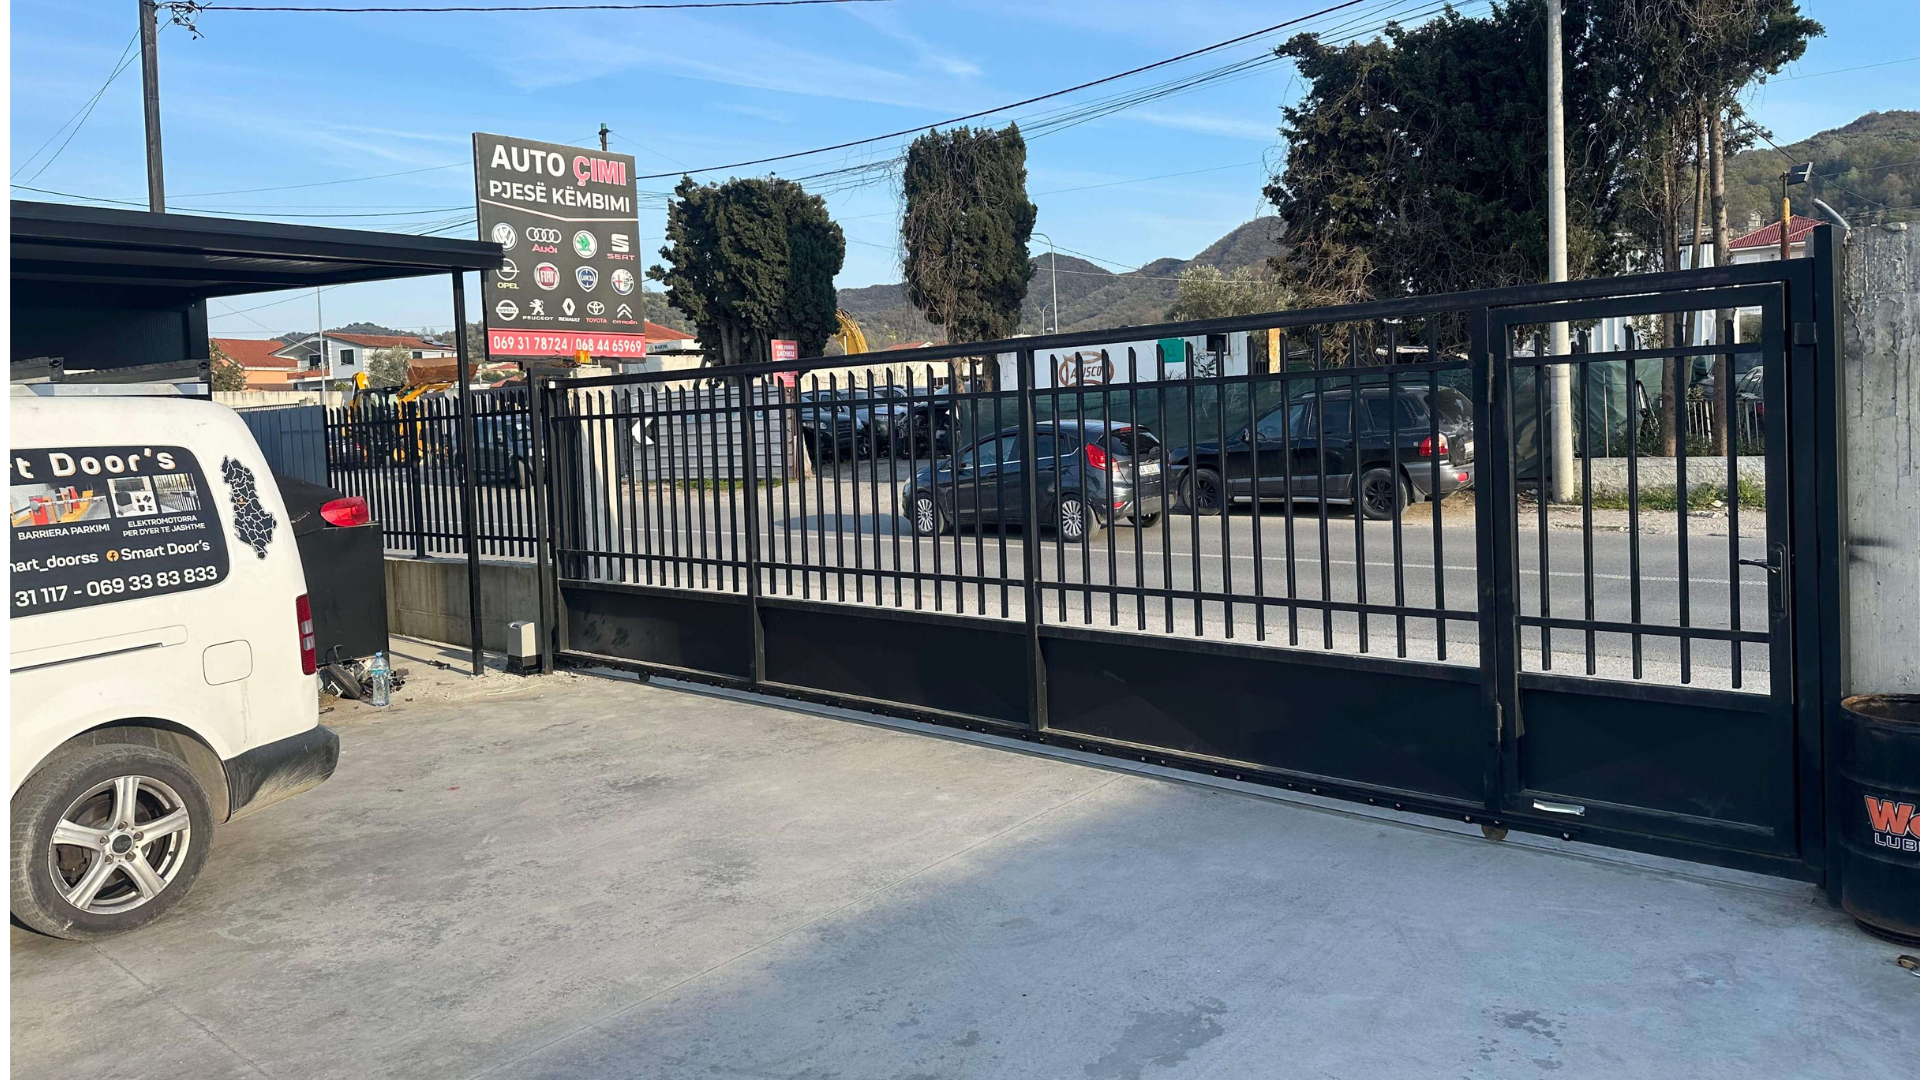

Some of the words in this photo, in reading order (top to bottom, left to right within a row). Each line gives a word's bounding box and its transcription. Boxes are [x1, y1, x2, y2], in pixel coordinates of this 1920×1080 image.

[491, 144, 566, 177] AUTO
[572, 155, 627, 187] ÇIMI
[489, 180, 548, 203] PJESË
[552, 186, 630, 213] KËMBIMI
[532, 244, 558, 254] Audi
[606, 253, 635, 261] SEAT
[497, 282, 520, 290] OPEL
[540, 270, 555, 284] FIAT
[493, 335, 515, 350] 069
[517, 336, 530, 350] 31
[534, 336, 568, 351] 78724
[569, 338, 574, 352] /
[575, 338, 594, 352] 068
[597, 339, 610, 352] 44
[612, 340, 642, 353] 65969
[48, 448, 176, 478] Door's
[122, 528, 139, 538] PER
[139, 526, 160, 536] DYER
[160, 525, 171, 534] TE
[171, 522, 206, 533] JASHTME
[127, 515, 198, 528] ELEKTROMOTORRA
[17, 527, 69, 541] BARRIERA
[70, 523, 110, 536] PARKIMI
[121, 545, 165, 561] Smart
[167, 539, 211, 555] Door's
[15, 589, 38, 607] 31
[40, 585, 68, 603] 117
[86, 578, 125, 597] 069
[128, 574, 153, 591] 33
[156, 570, 181, 587] 83
[183, 565, 218, 584] 833
[1874, 832, 1920, 852] LUB
